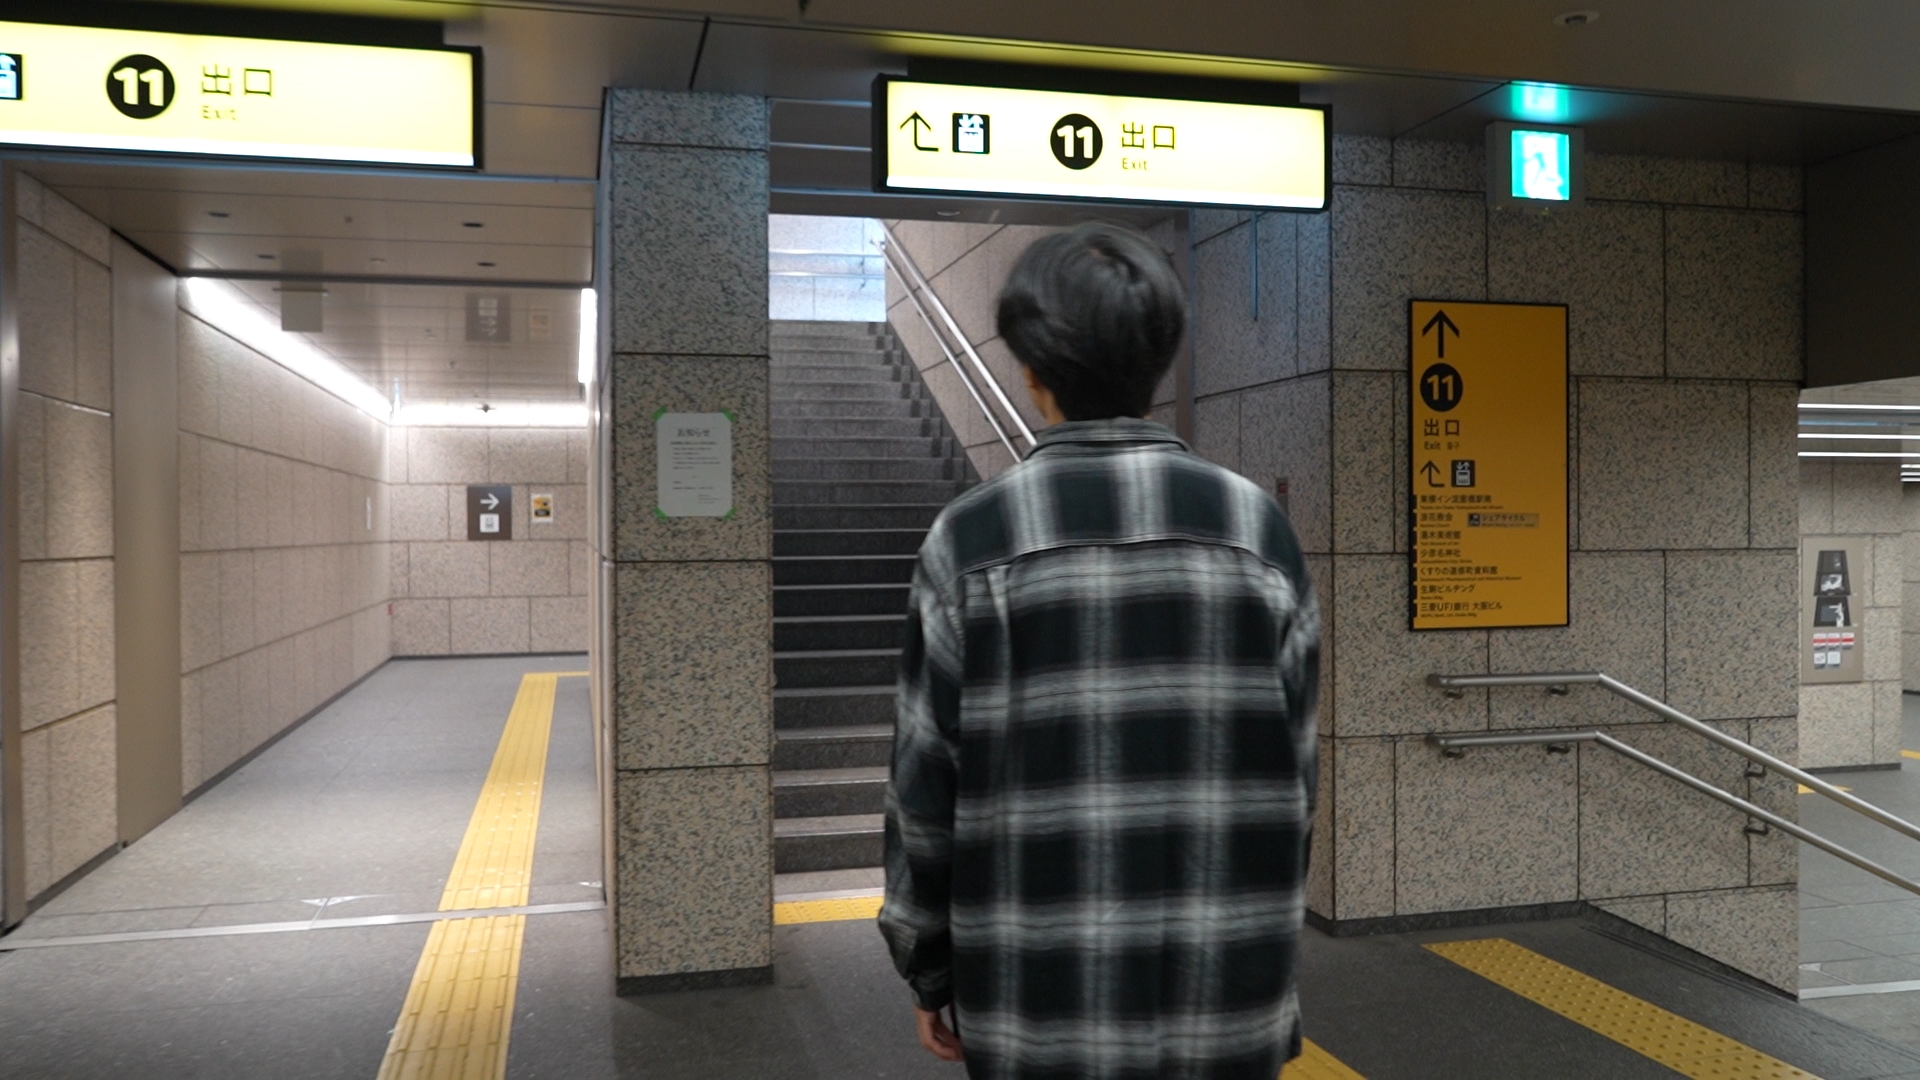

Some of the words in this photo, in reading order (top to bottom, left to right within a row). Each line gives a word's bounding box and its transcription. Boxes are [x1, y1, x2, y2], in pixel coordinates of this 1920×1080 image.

[113, 67, 164, 106] 11
[202, 64, 272, 96] 出口
[202, 105, 237, 121] Exit
[1056, 124, 1094, 158] 11
[1121, 122, 1175, 149] 出口
[1122, 157, 1148, 170] Exit
[1426, 374, 1456, 402] 11
[1424, 418, 1460, 436] 出口
[1424, 441, 1441, 450] Exit
[1472, 601, 1503, 610] 大阪ビル
